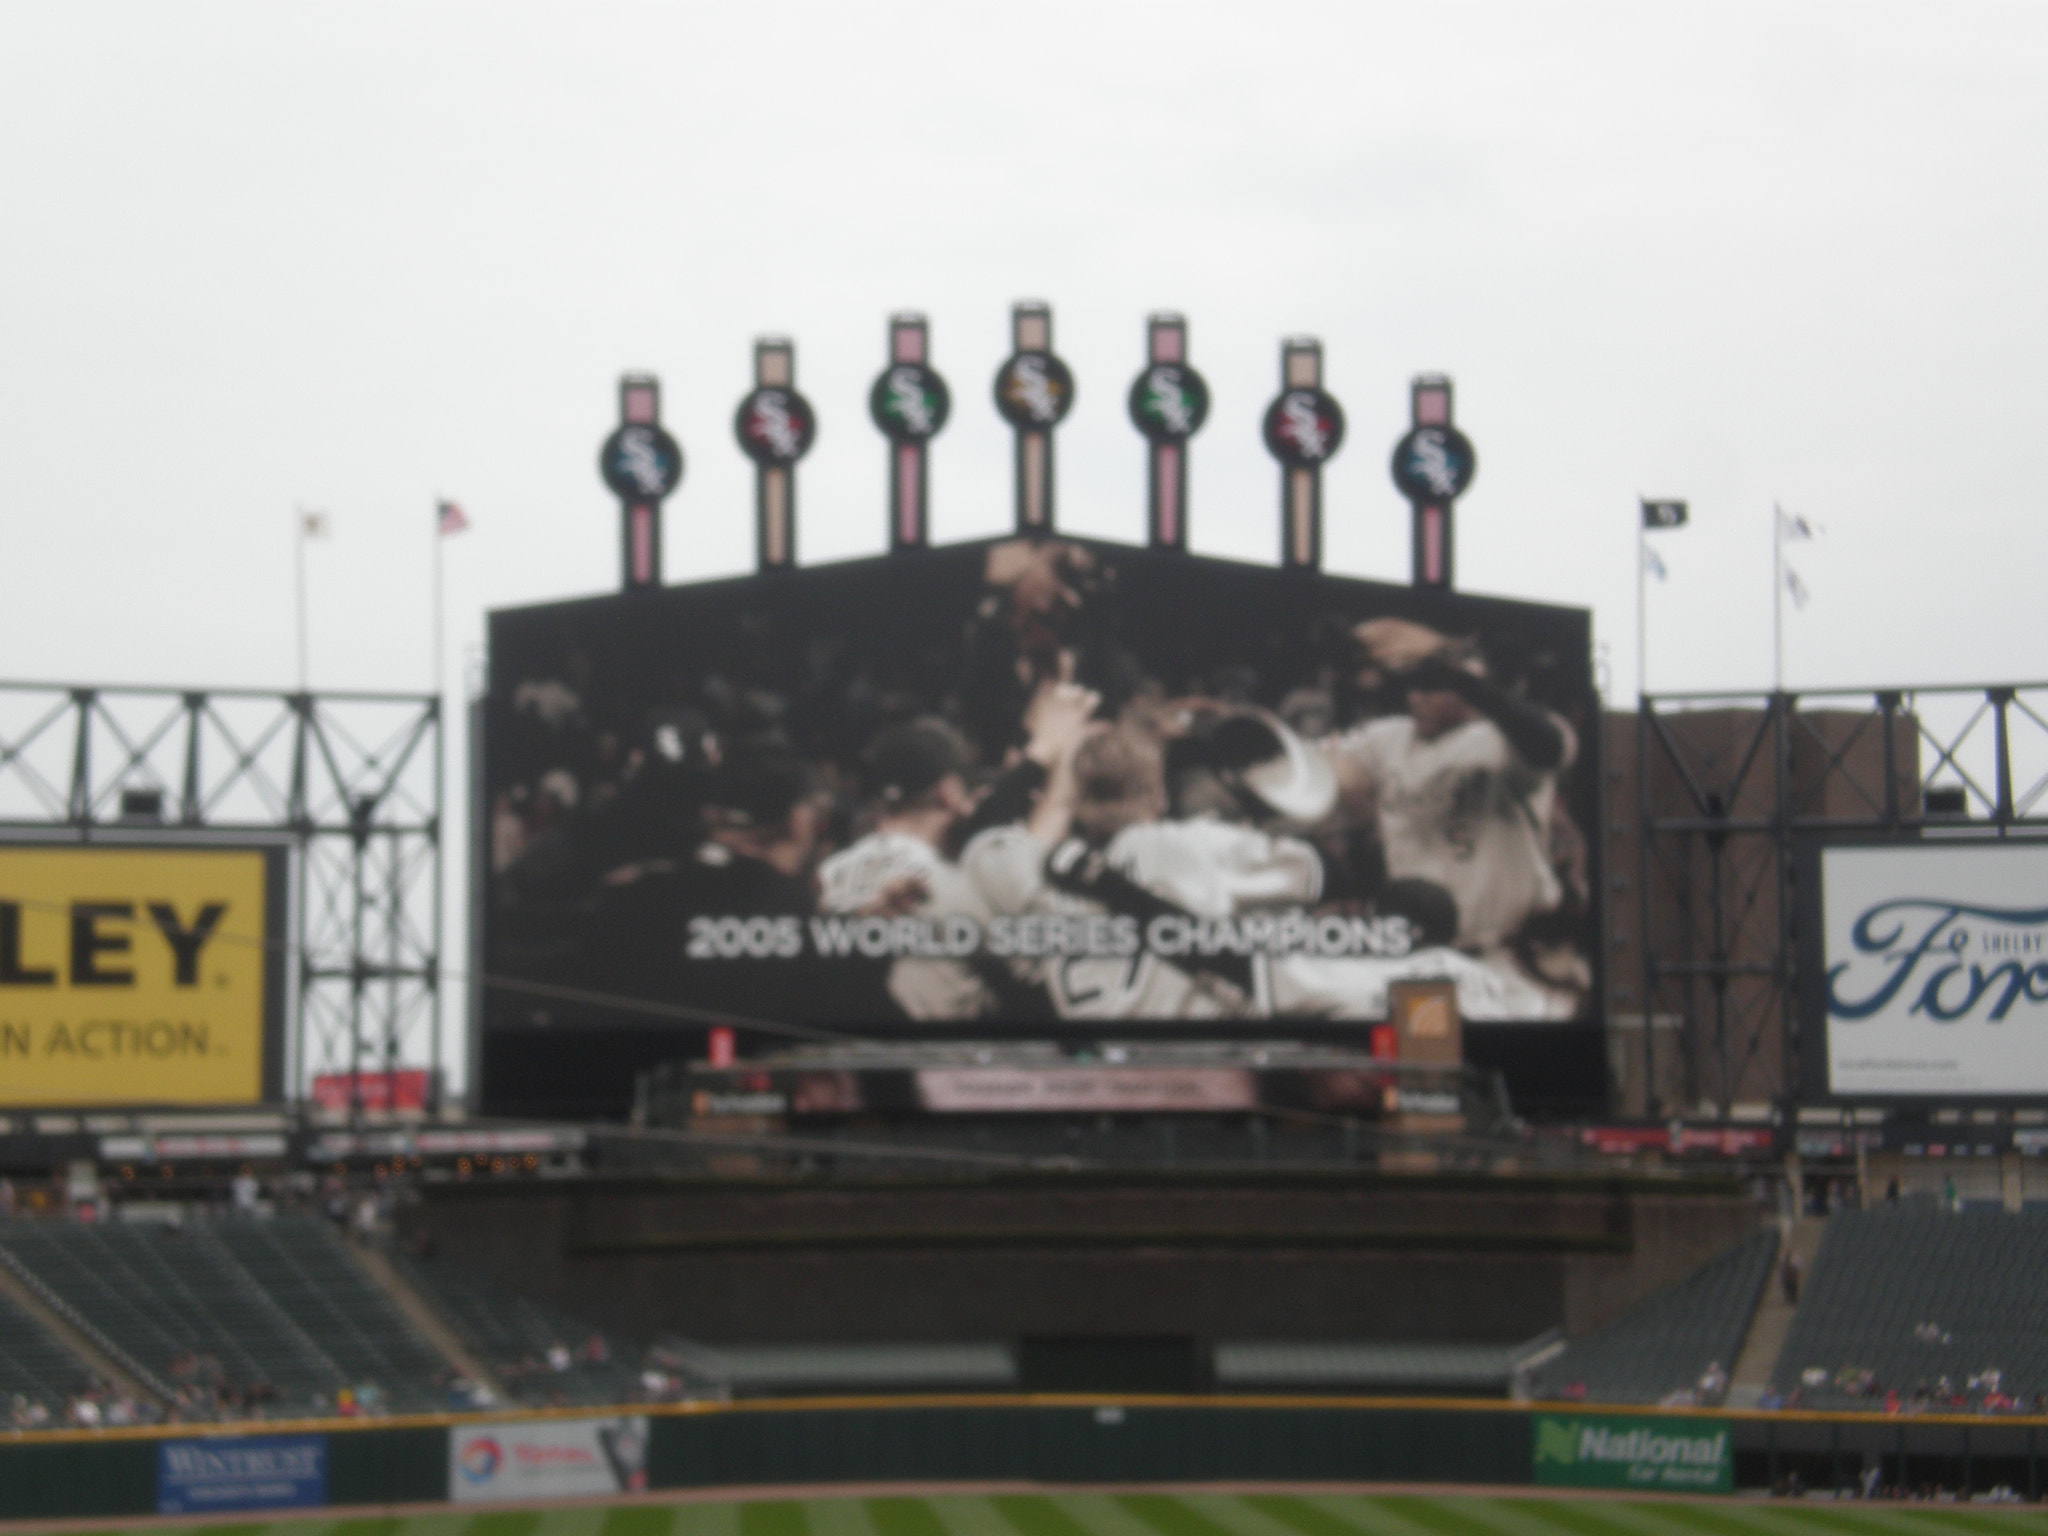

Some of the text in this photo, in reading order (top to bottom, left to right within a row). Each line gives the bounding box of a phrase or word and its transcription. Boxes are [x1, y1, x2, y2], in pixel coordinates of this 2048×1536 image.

[687, 912, 1411, 957] 2005 WORLD SERIES CHAMPIONS
[1578, 1427, 1726, 1465] National
